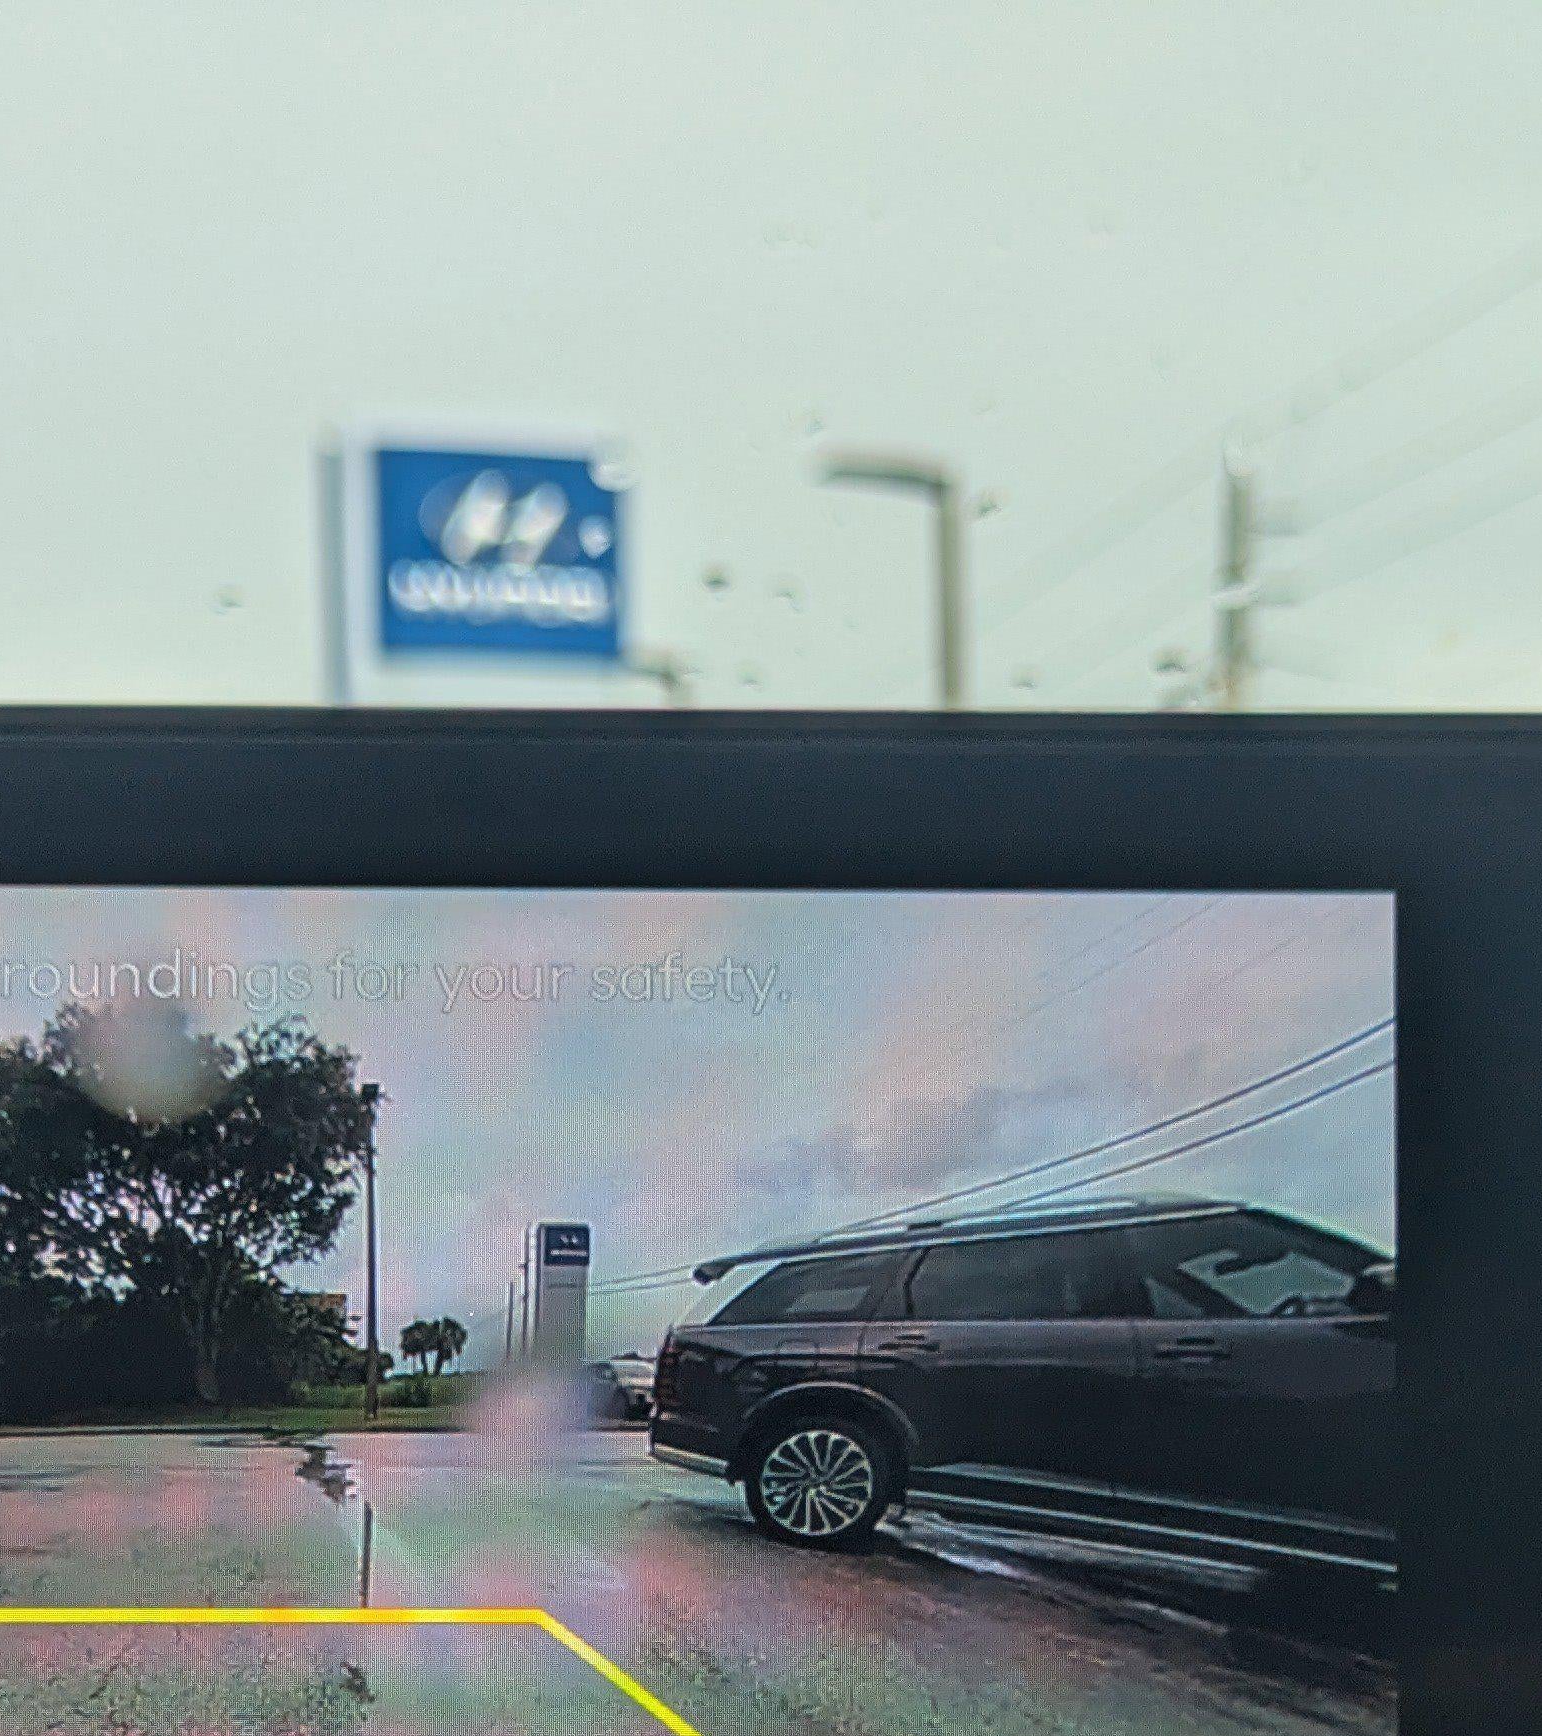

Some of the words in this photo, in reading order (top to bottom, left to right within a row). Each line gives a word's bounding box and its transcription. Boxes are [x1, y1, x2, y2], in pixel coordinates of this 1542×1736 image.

[326, 947, 417, 1003] for
[434, 958, 575, 1012] your
[586, 949, 793, 1013] safety.
